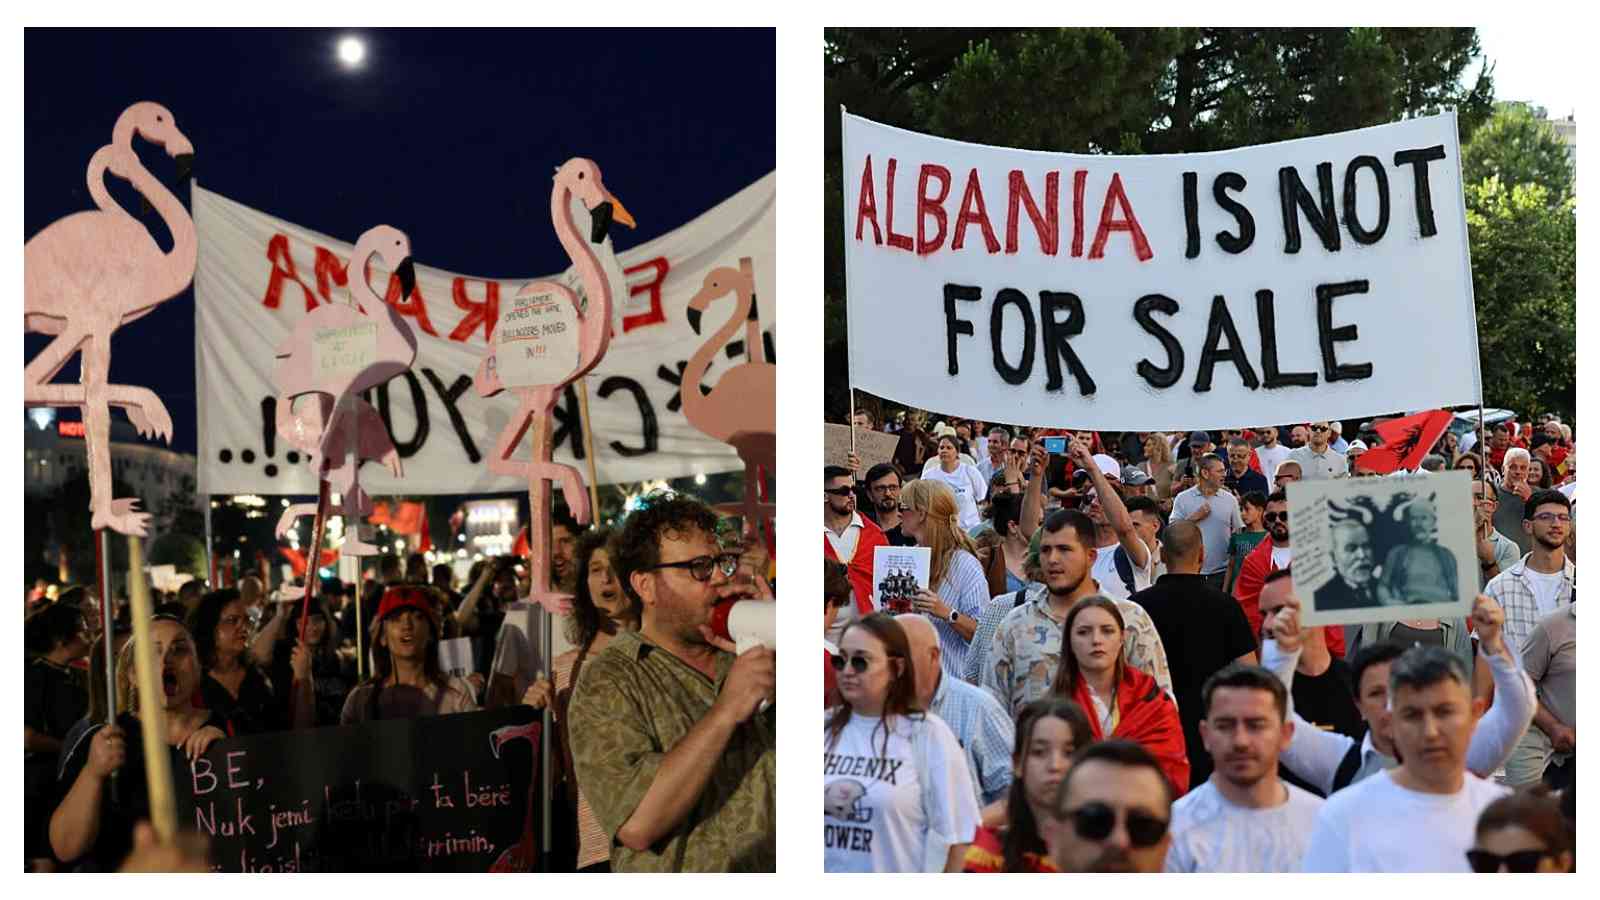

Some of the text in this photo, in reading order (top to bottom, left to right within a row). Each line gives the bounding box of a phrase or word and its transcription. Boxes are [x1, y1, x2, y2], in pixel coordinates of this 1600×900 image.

[855, 145, 1446, 261] ALBANIA IS NOT
[943, 279, 1374, 396] FOR SALE
[190, 750, 264, 795] BE,
[824, 753, 902, 785] HOENIX
[194, 797, 256, 836] Nuk
[265, 799, 313, 849] jemi
[824, 824, 873, 853] OWER
